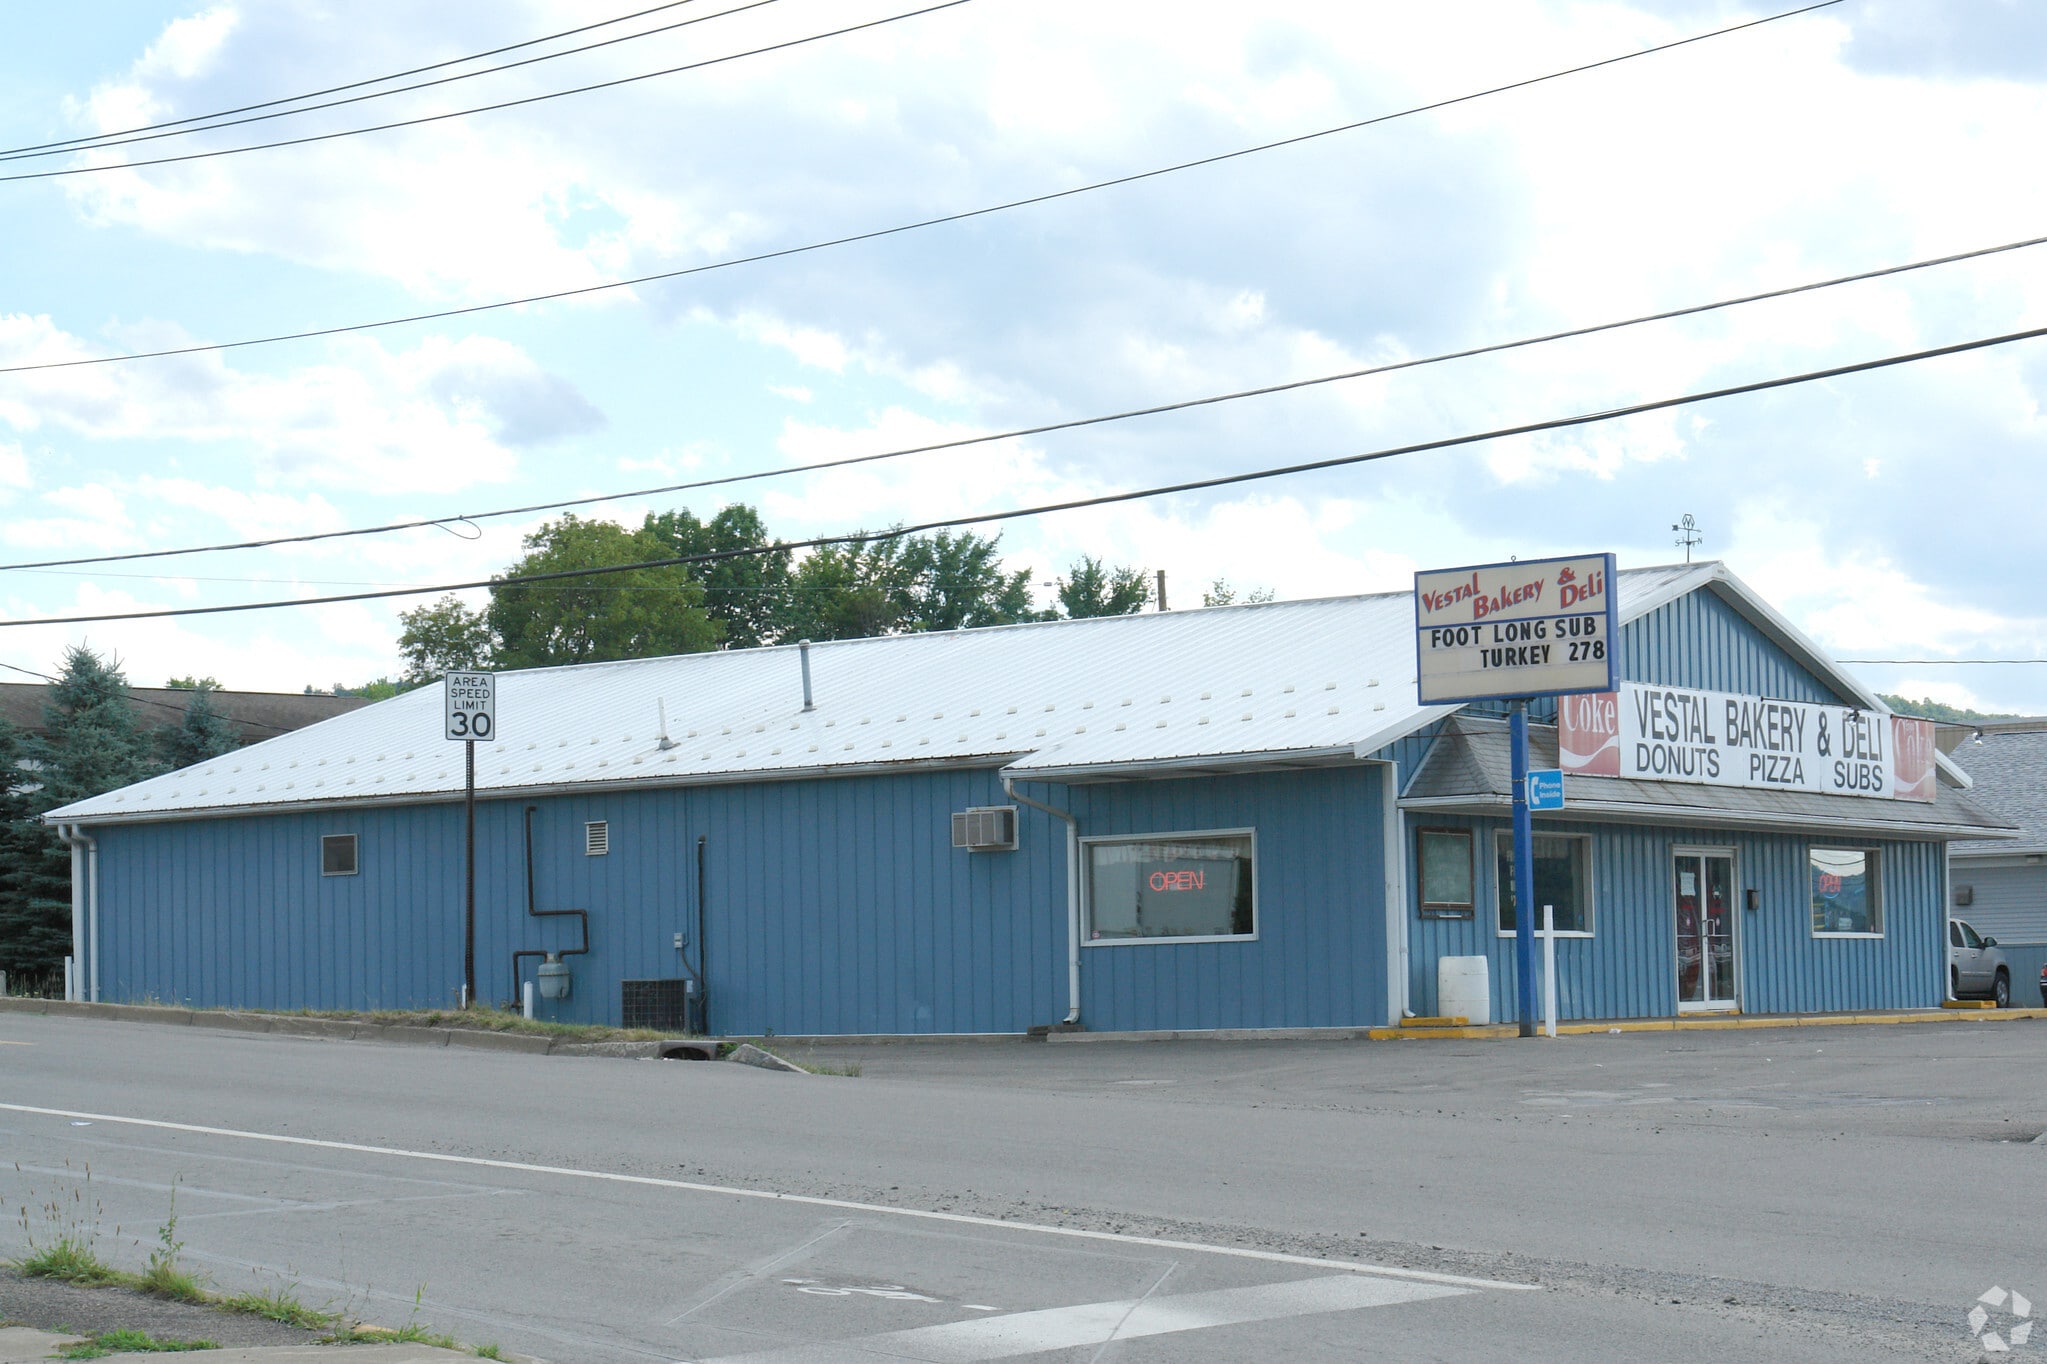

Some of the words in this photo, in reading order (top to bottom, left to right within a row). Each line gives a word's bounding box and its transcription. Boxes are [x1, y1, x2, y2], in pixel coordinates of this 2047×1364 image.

[1557, 567, 1576, 585] &
[1431, 626, 1482, 648] FOOT
[1494, 620, 1547, 643] LONG
[1555, 616, 1597, 639] SUB
[1480, 644, 1551, 668] TURKEY
[1569, 640, 1605, 662] 278
[453, 677, 488, 687] AREA
[451, 688, 490, 699] SPEED
[454, 700, 486, 710] LIMIT
[1563, 693, 1616, 734] Coke
[451, 711, 491, 737] 30
[1634, 689, 1716, 744] VESTAL
[1726, 699, 1806, 753] BAKERY
[1817, 711, 1832, 757] &
[1842, 714, 1883, 762] DELI
[1636, 742, 1720, 778] DONUTS
[1750, 753, 1805, 785] PIZZA
[1834, 760, 1883, 792] SUBS
[1539, 782, 1562, 790] Phone
[1149, 870, 1205, 892] OPEN
[1819, 874, 1841, 893] OPEN
